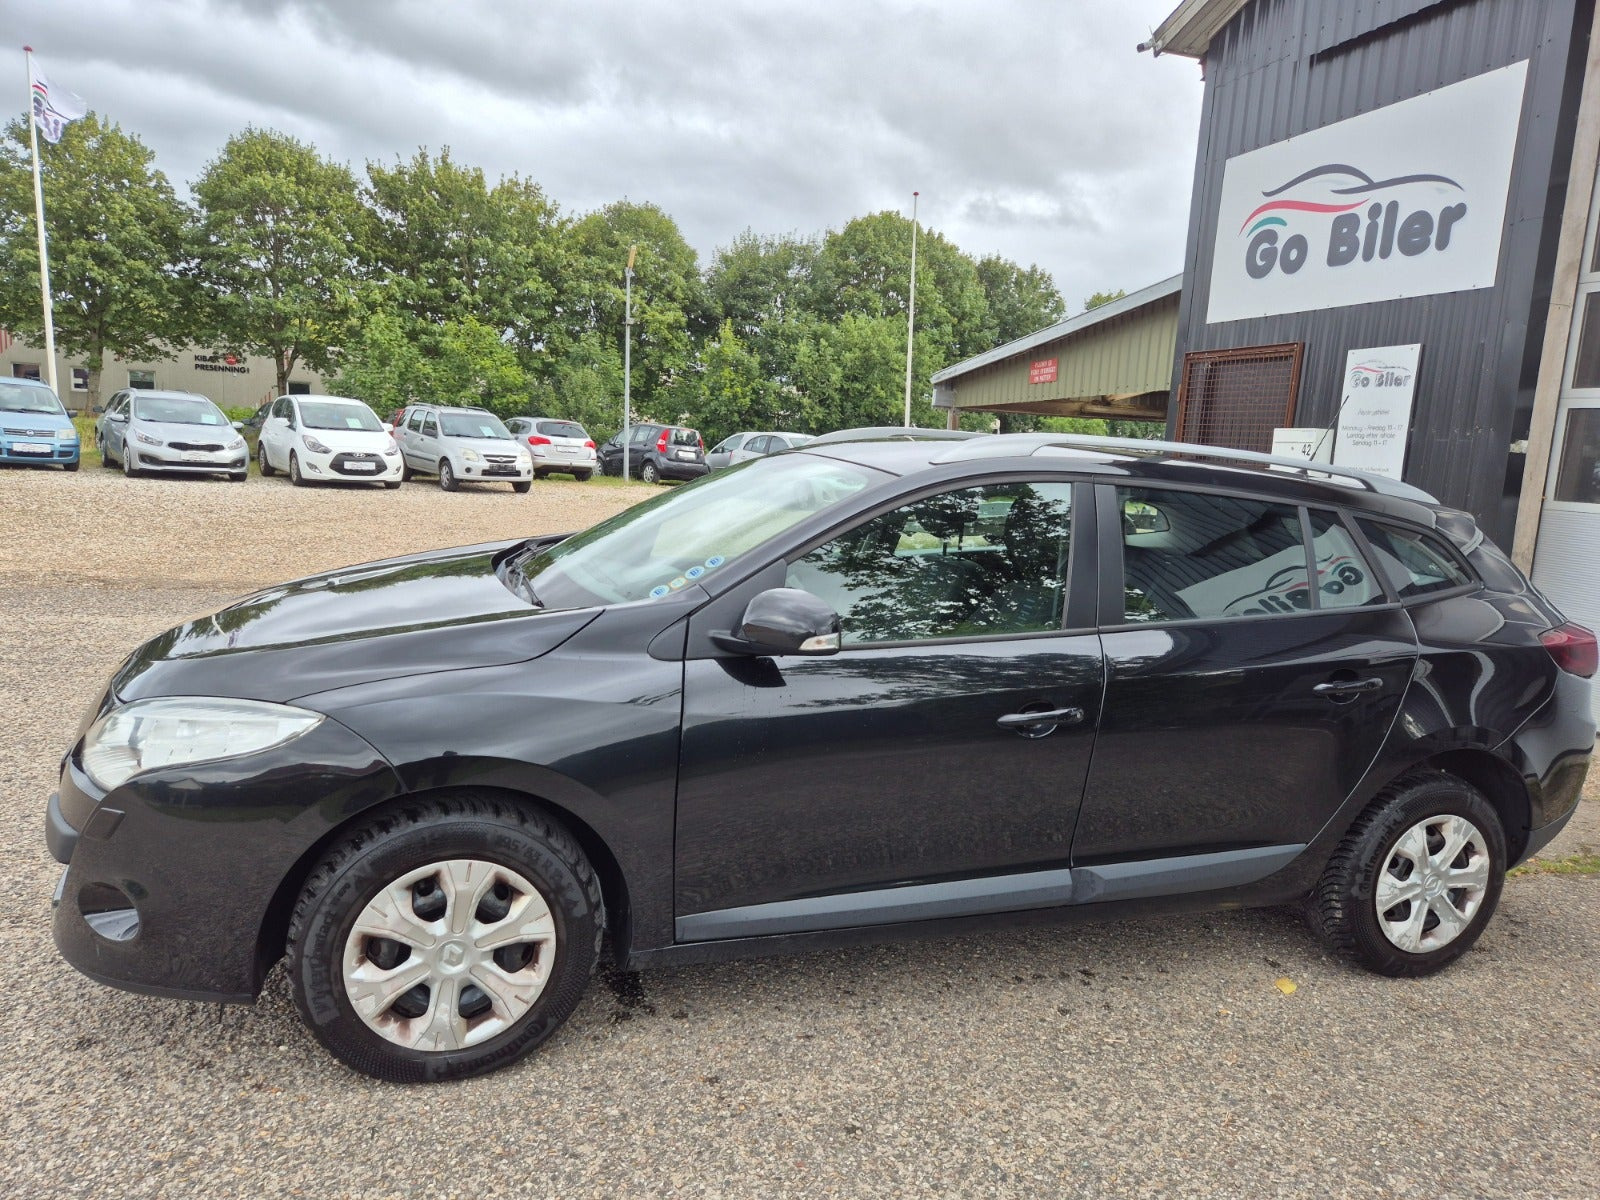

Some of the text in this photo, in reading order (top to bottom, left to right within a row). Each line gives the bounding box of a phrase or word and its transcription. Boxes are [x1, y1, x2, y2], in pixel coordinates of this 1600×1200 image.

[1246, 200, 1467, 279] Go Biler
[1351, 371, 1411, 388] Go Biler
[1302, 443, 1312, 456] 42
